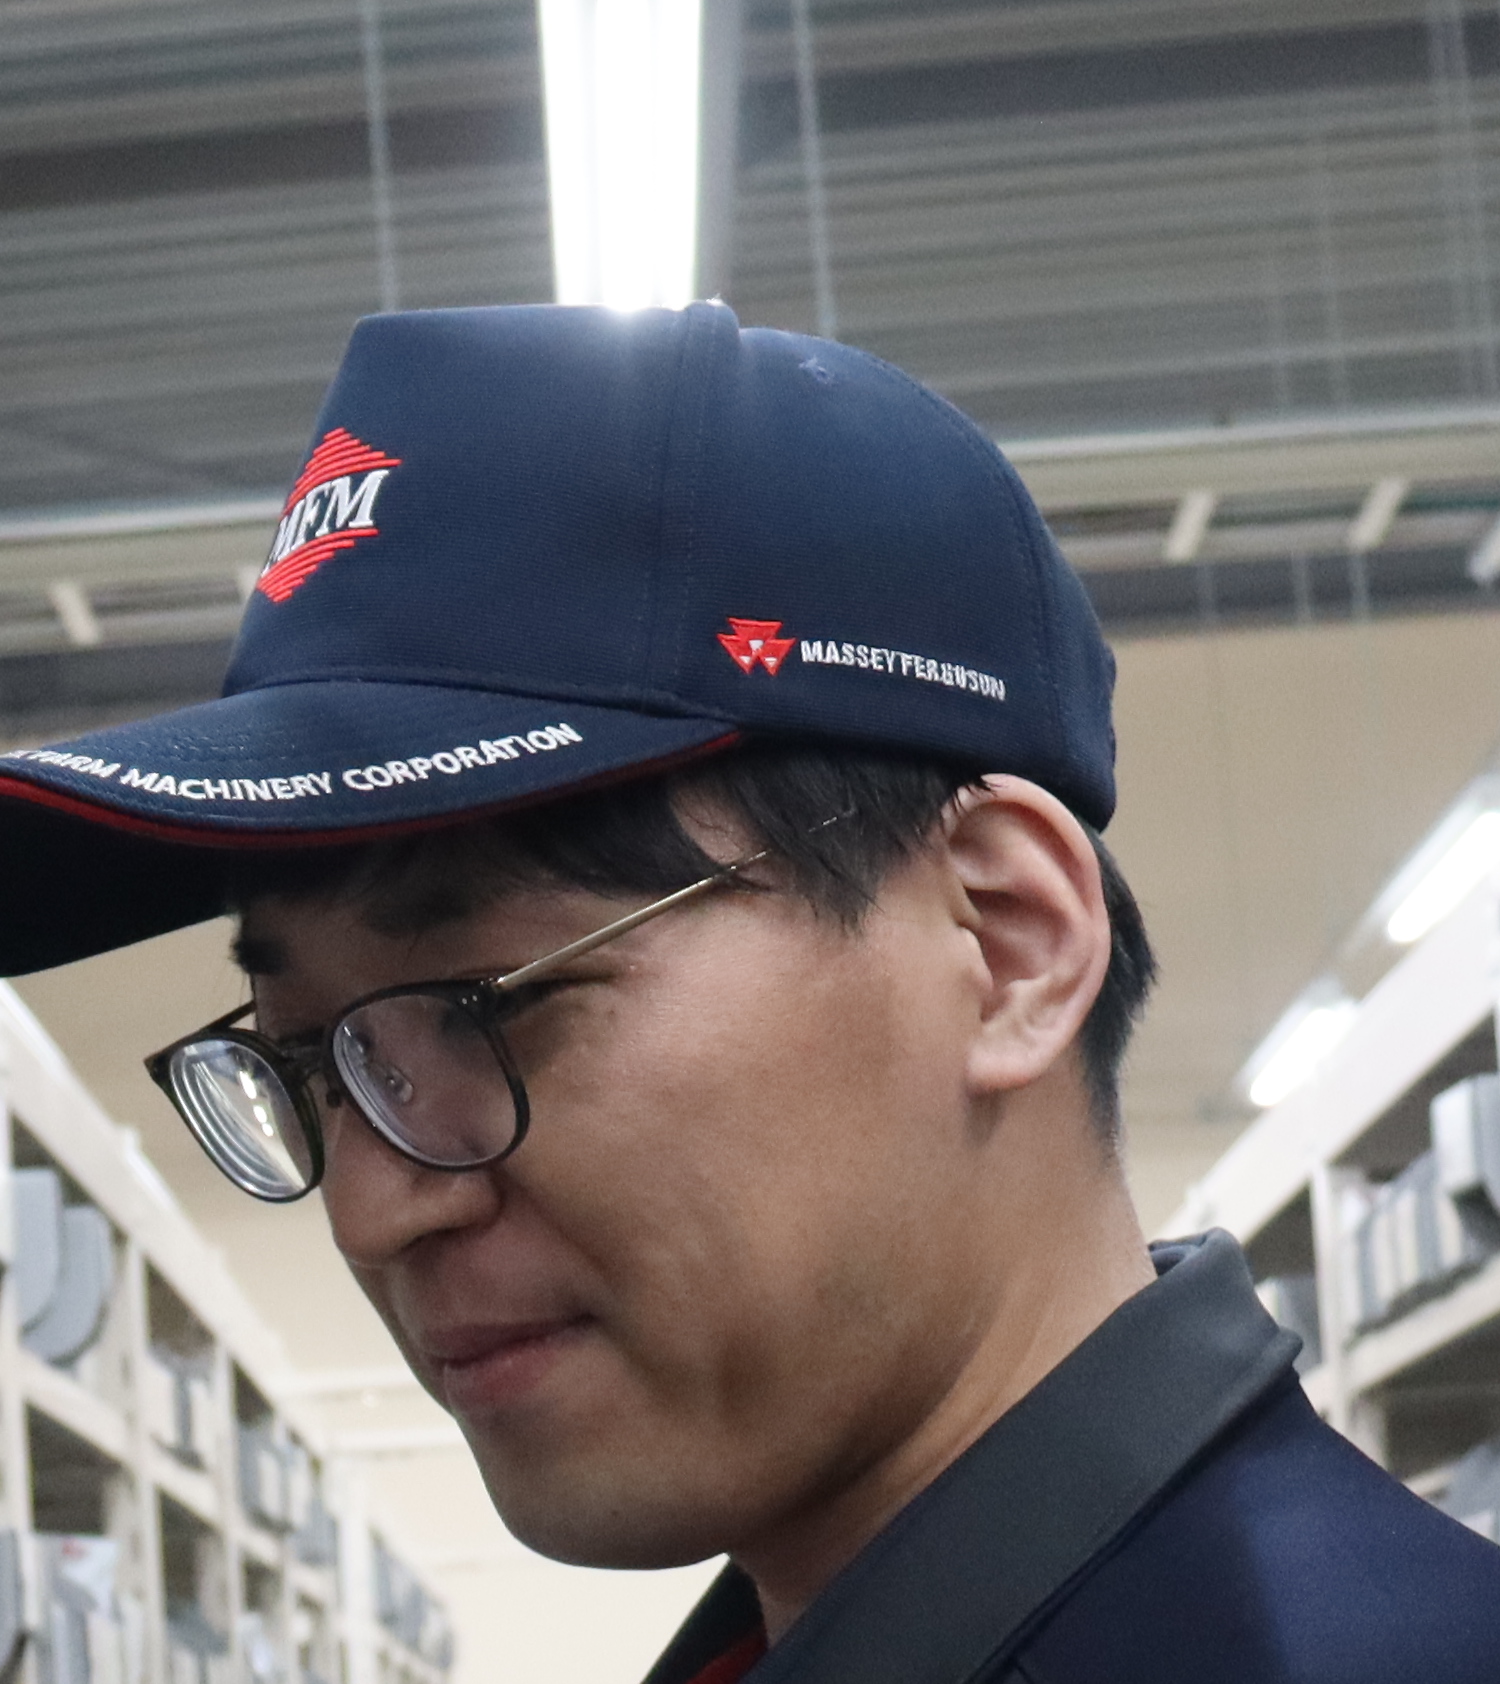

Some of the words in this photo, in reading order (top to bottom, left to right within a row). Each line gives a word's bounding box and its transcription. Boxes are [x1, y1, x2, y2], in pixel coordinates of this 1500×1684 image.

[261, 469, 390, 577] MFM
[119, 768, 332, 801] MACHINERY
[341, 722, 584, 791] CORPORATION
